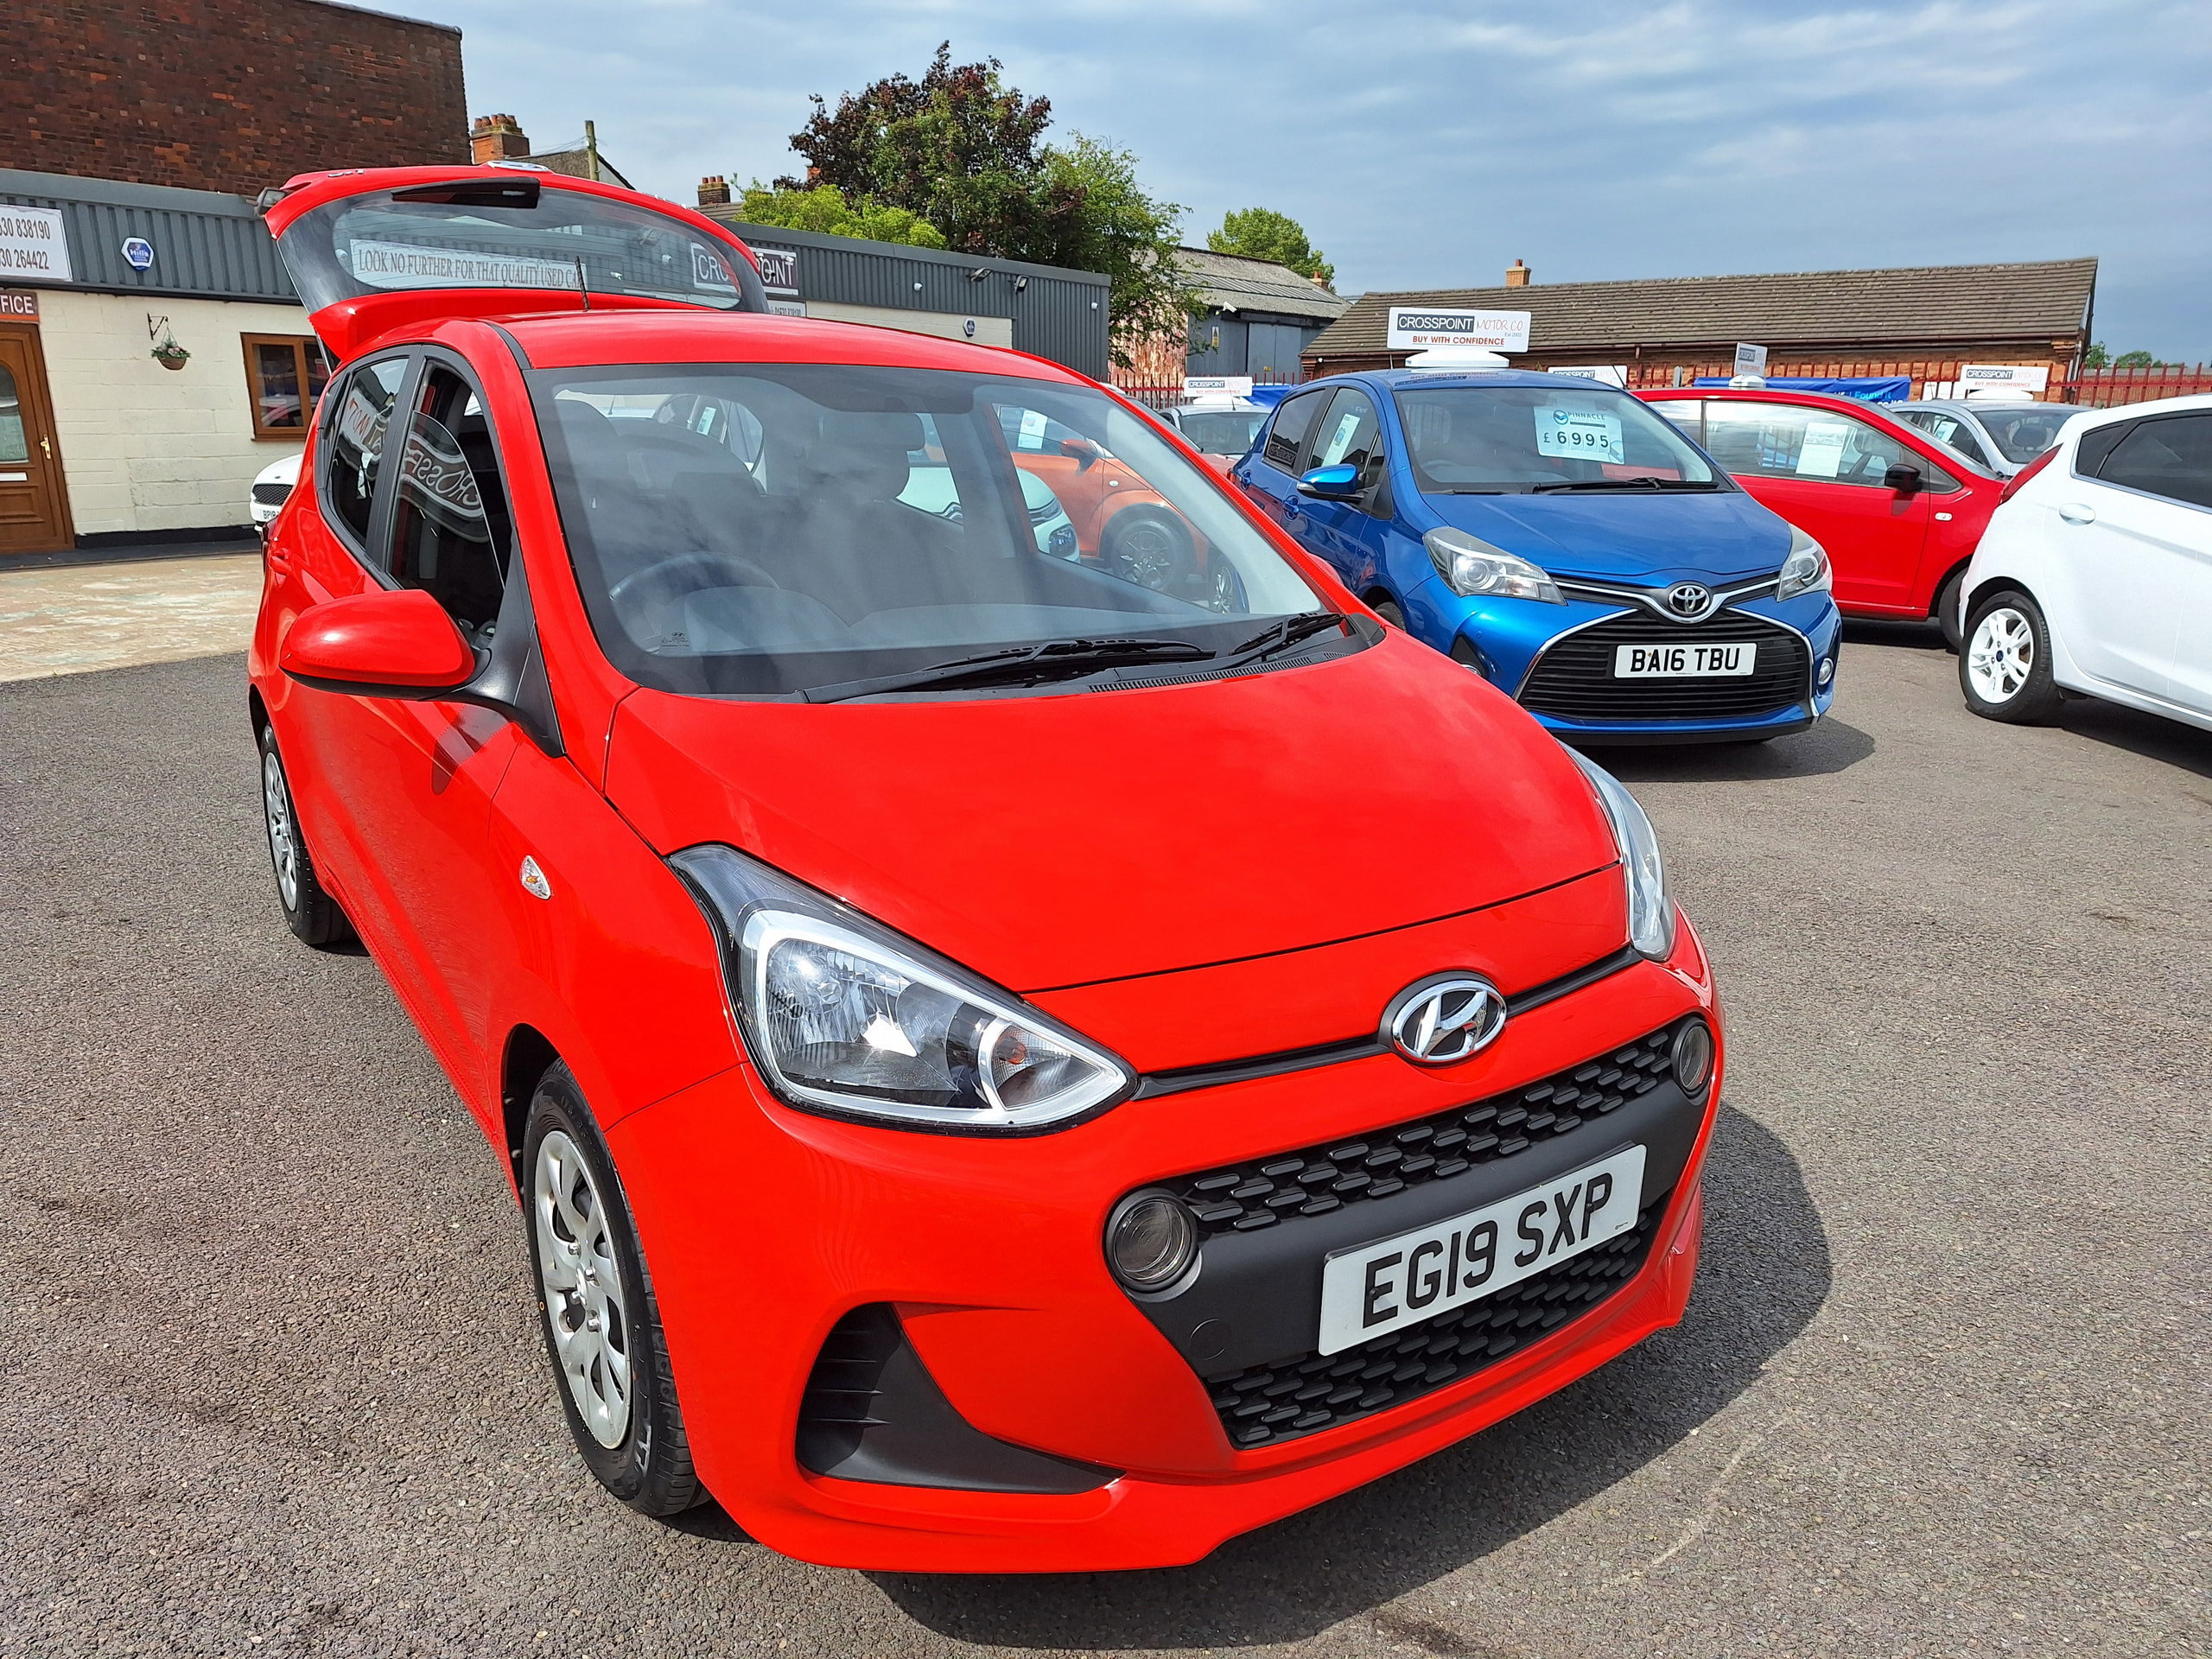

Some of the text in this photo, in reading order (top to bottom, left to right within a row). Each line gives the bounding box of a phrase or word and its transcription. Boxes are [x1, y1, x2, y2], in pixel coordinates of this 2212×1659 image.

[0, 217, 50, 240] 30 838190
[14, 249, 49, 270] 264422
[359, 250, 582, 289] LOOK NO FURTHER FOR THAT QUALITY USED CA
[1398, 316, 1523, 331] CROSSPOINT MOTOR CO
[1452, 336, 1505, 346] CONFIDENCE
[1967, 370, 2012, 378] CROSSPOINT
[1567, 411, 1605, 421] PINNACLE
[1543, 431, 1609, 448] £ 6995
[1630, 648, 1740, 672] BA16 TBU
[1363, 1173, 1613, 1329] EG19 SXP
